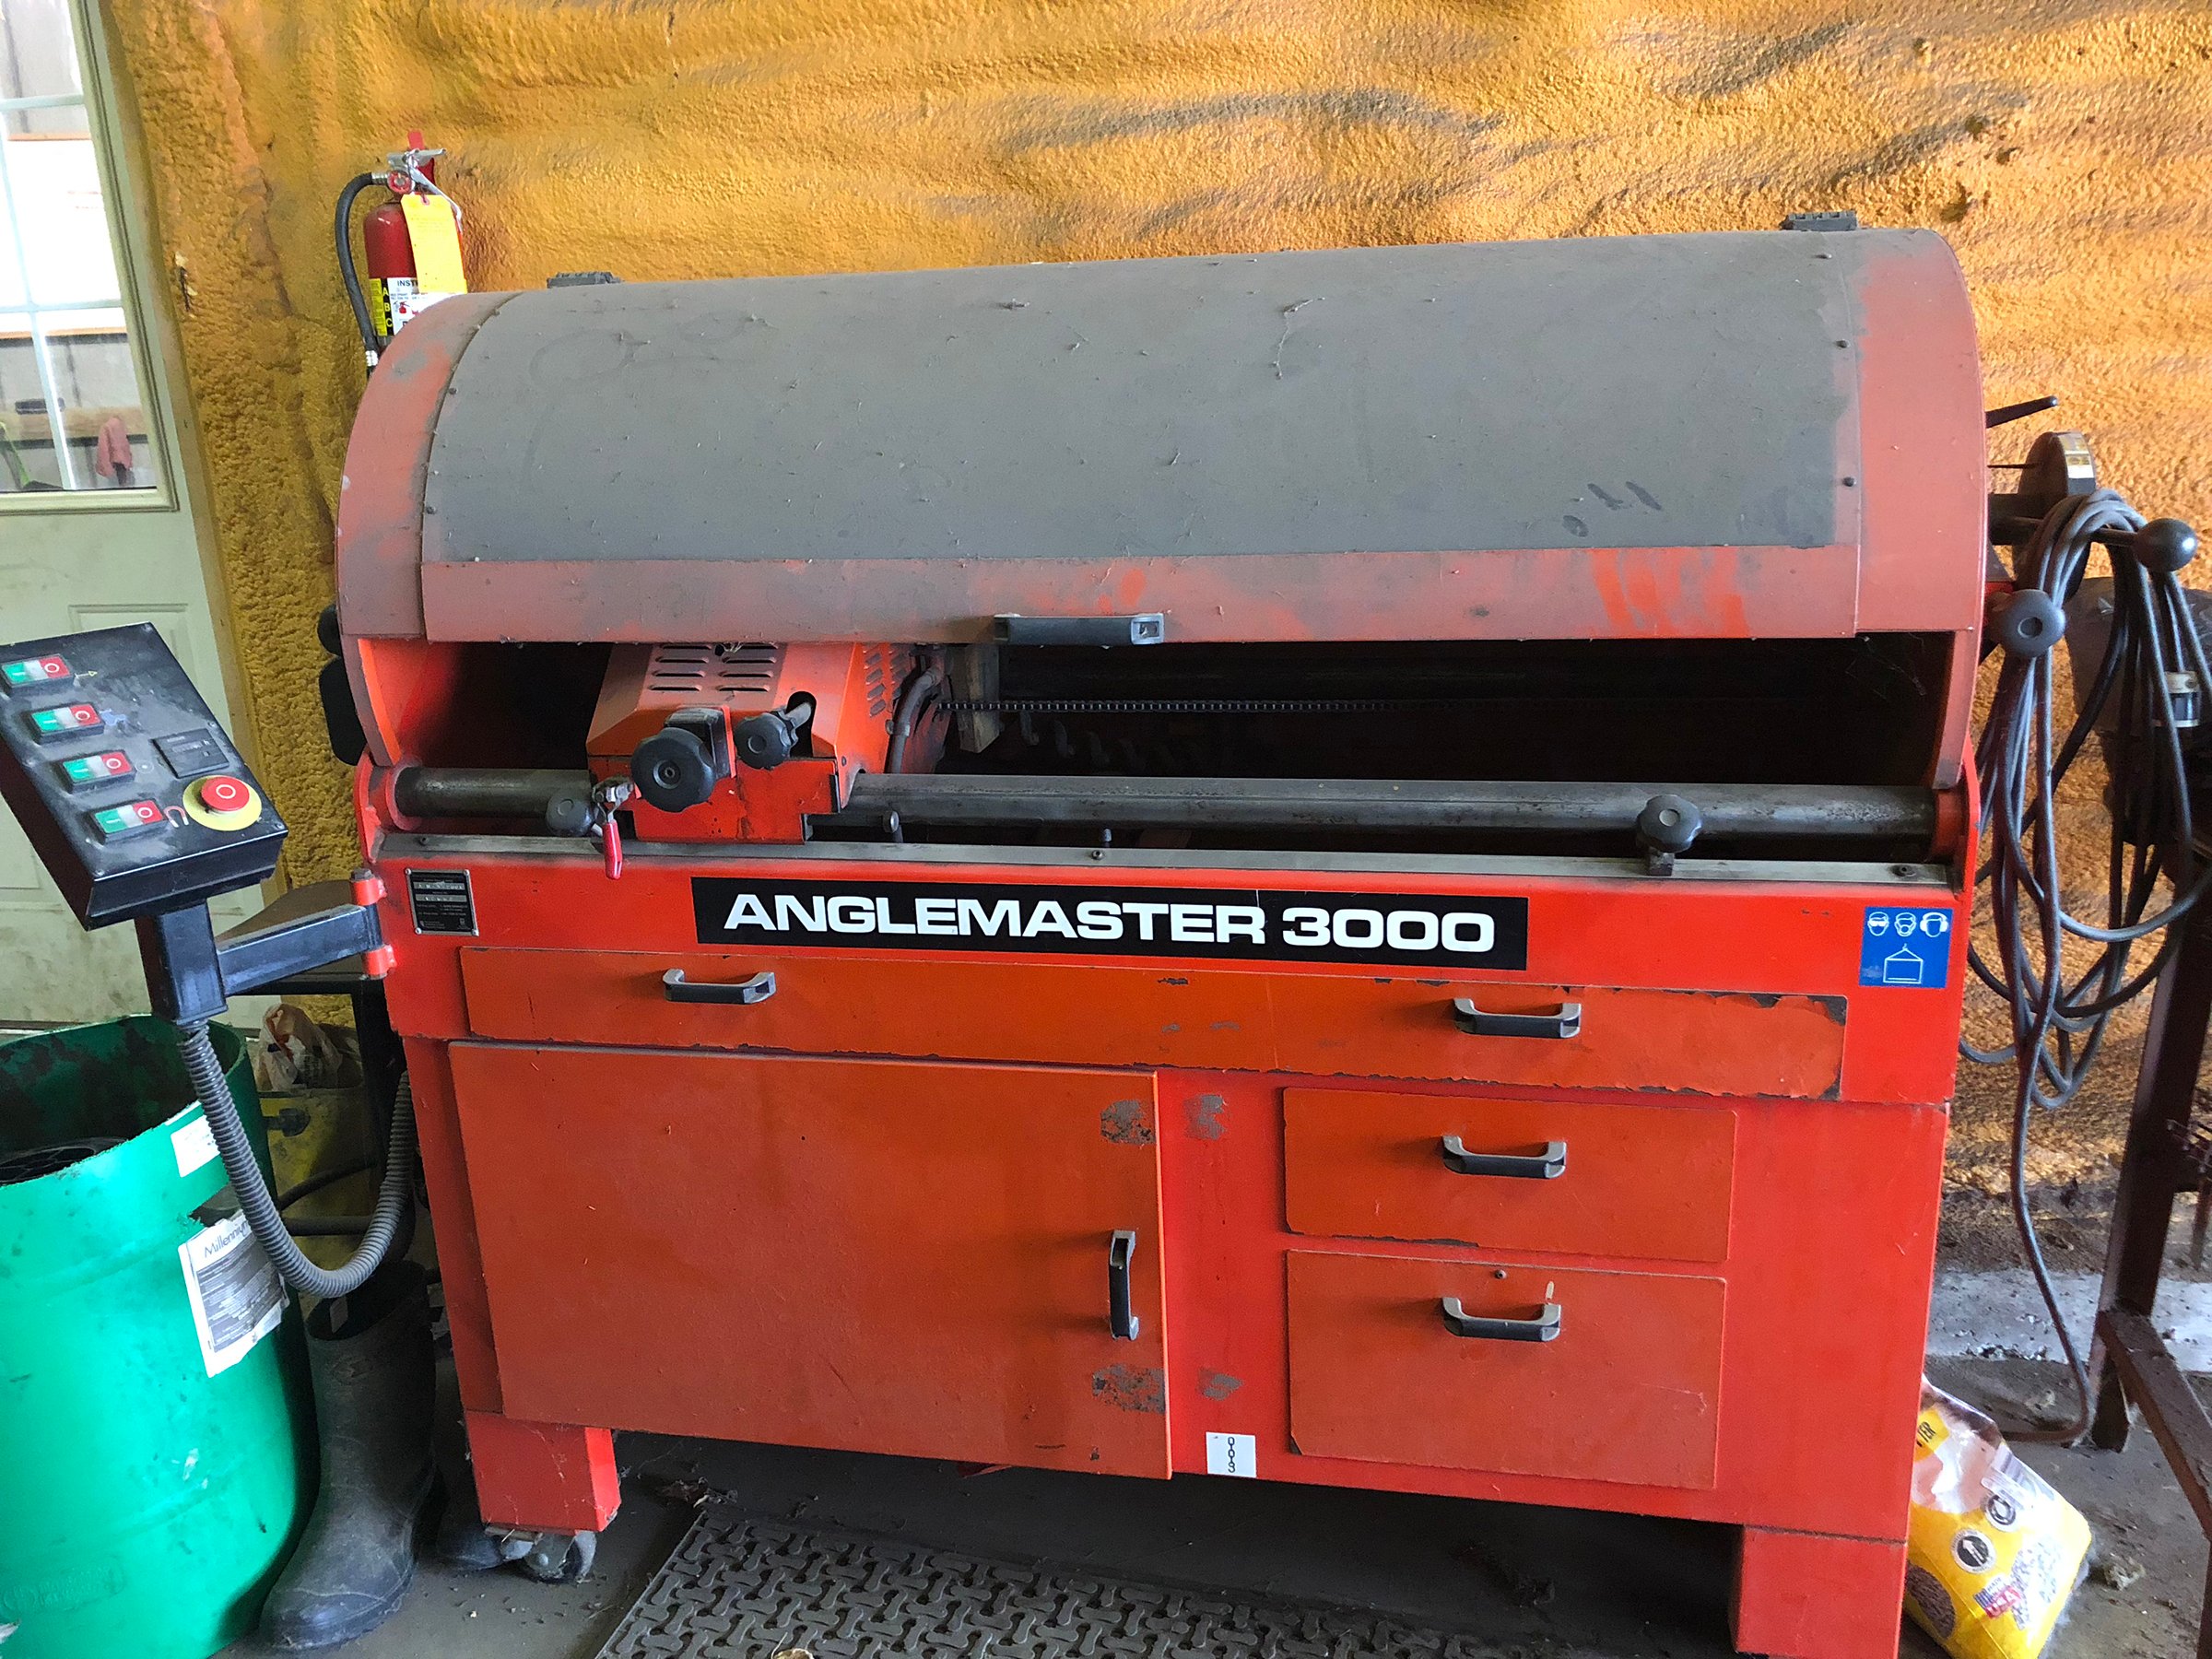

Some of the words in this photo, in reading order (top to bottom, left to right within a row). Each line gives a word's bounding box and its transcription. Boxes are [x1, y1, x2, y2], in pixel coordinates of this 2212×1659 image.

[382, 287, 389, 296] A
[384, 302, 390, 312] B
[386, 318, 393, 327] C
[724, 893, 1265, 945] ANGLEMASTER
[1282, 907, 1495, 953] 3000
